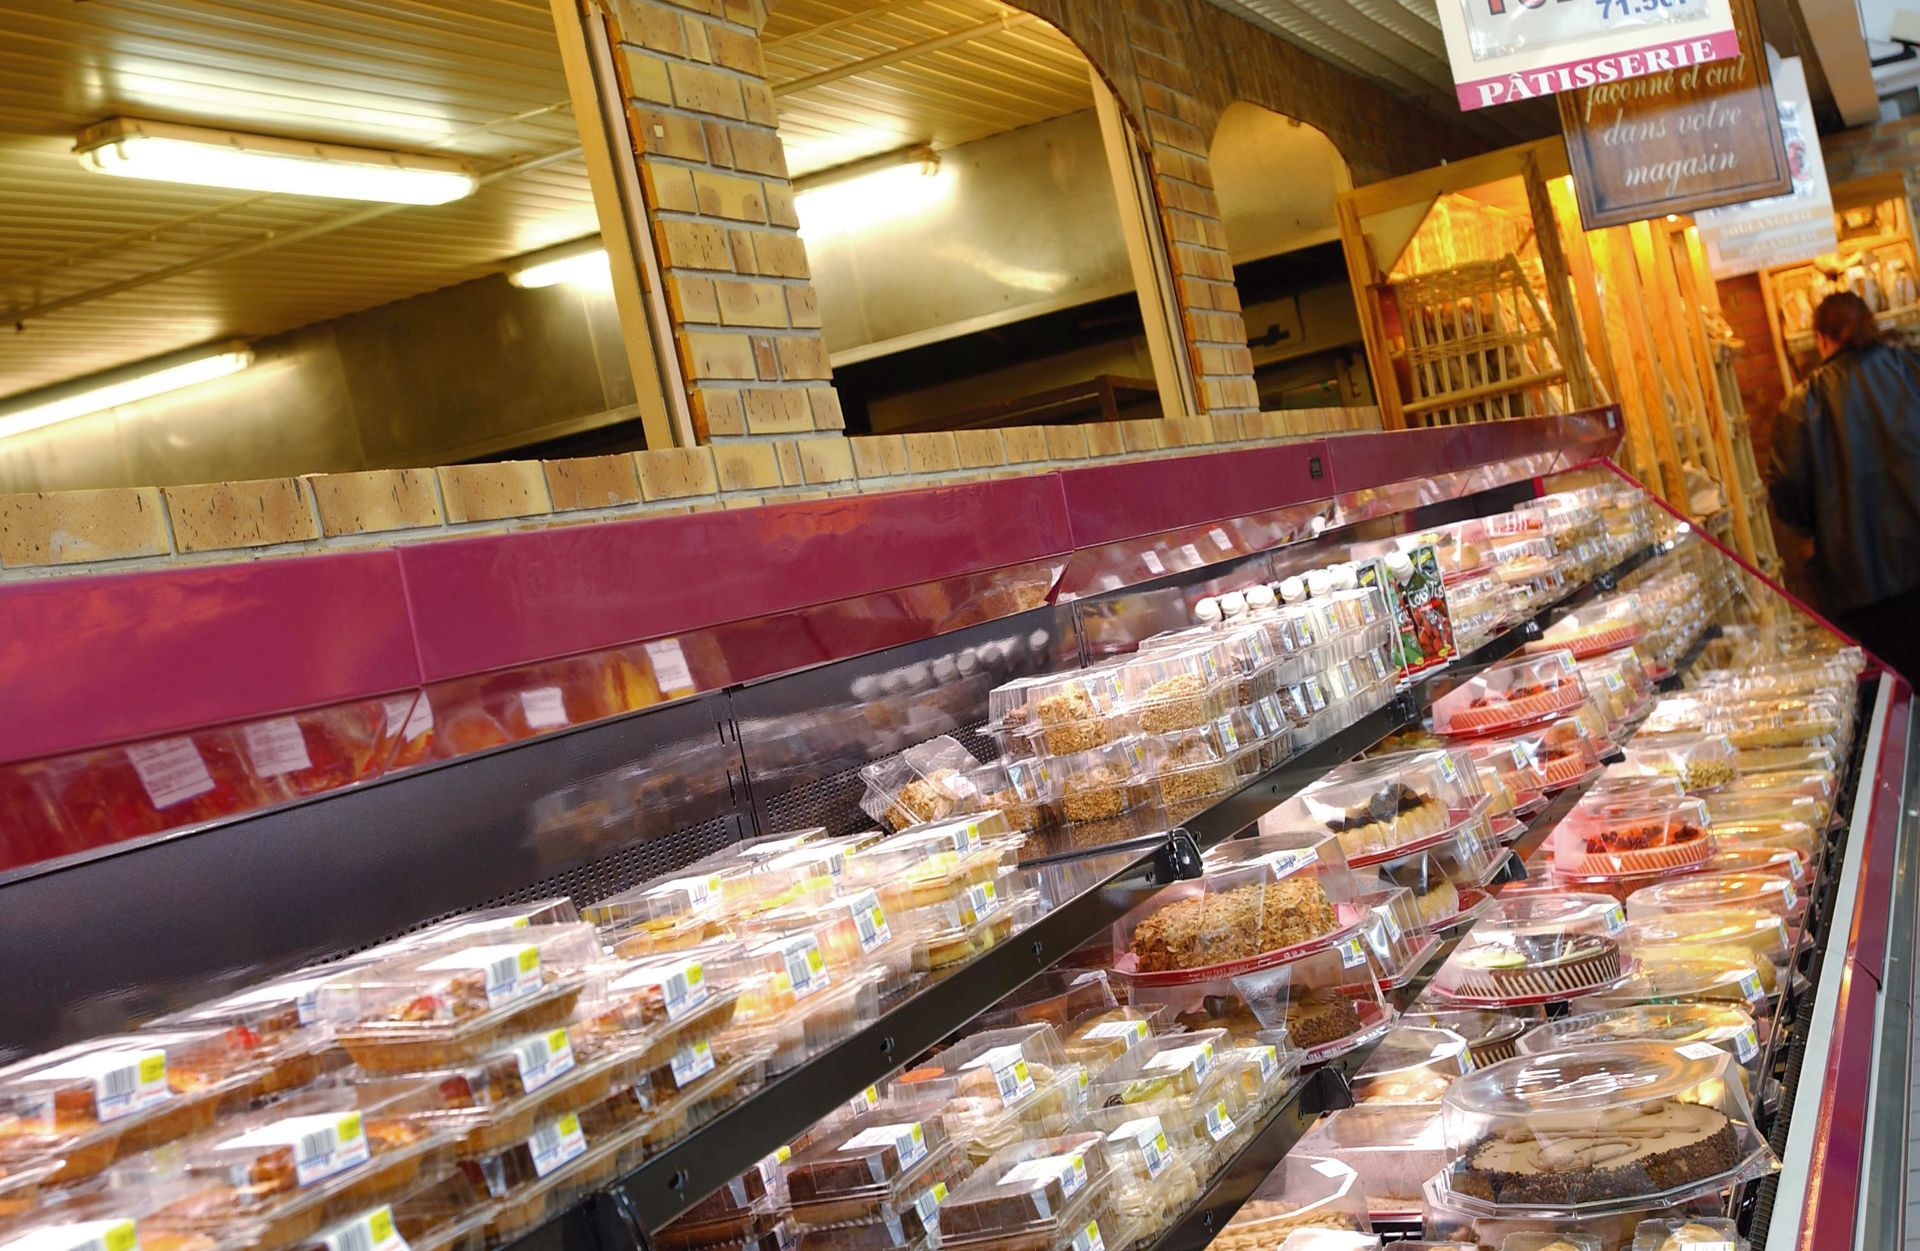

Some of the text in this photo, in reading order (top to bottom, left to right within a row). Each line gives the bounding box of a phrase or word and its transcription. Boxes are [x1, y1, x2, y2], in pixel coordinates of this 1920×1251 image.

[1476, 39, 1717, 109] PÂTISSERIE
[1680, 63, 1700, 91] et
[1705, 54, 1746, 87] cuit
[1603, 108, 1667, 147] dans
[1678, 101, 1743, 135] votre
[1624, 143, 1738, 196] magasin
